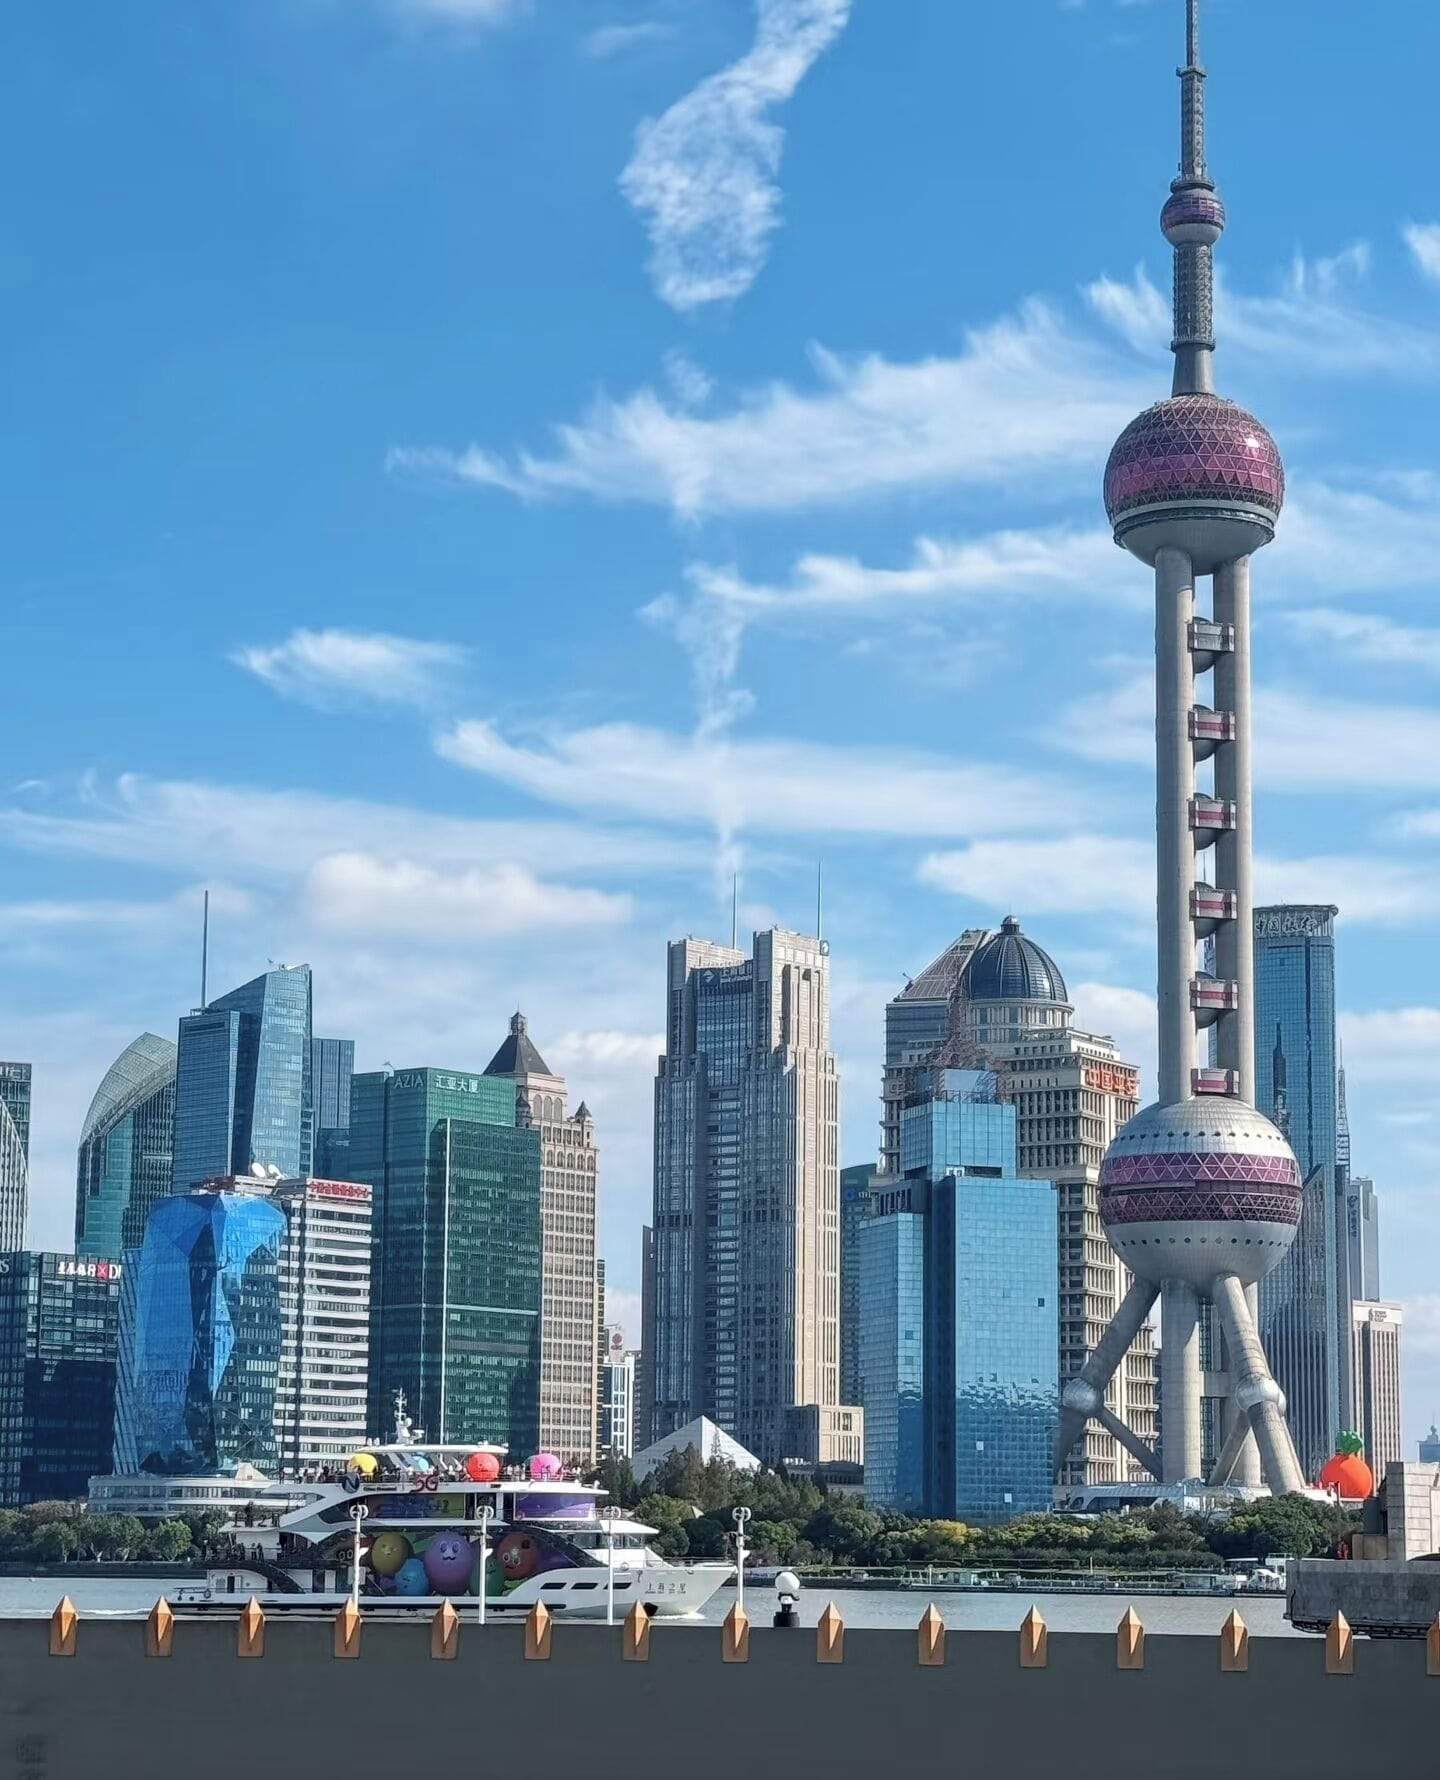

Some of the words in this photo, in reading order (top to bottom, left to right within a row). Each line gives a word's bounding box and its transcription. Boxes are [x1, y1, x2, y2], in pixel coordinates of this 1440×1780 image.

[394, 1073, 424, 1089] AZIA
[435, 1074, 479, 1094] 汇亚大厦
